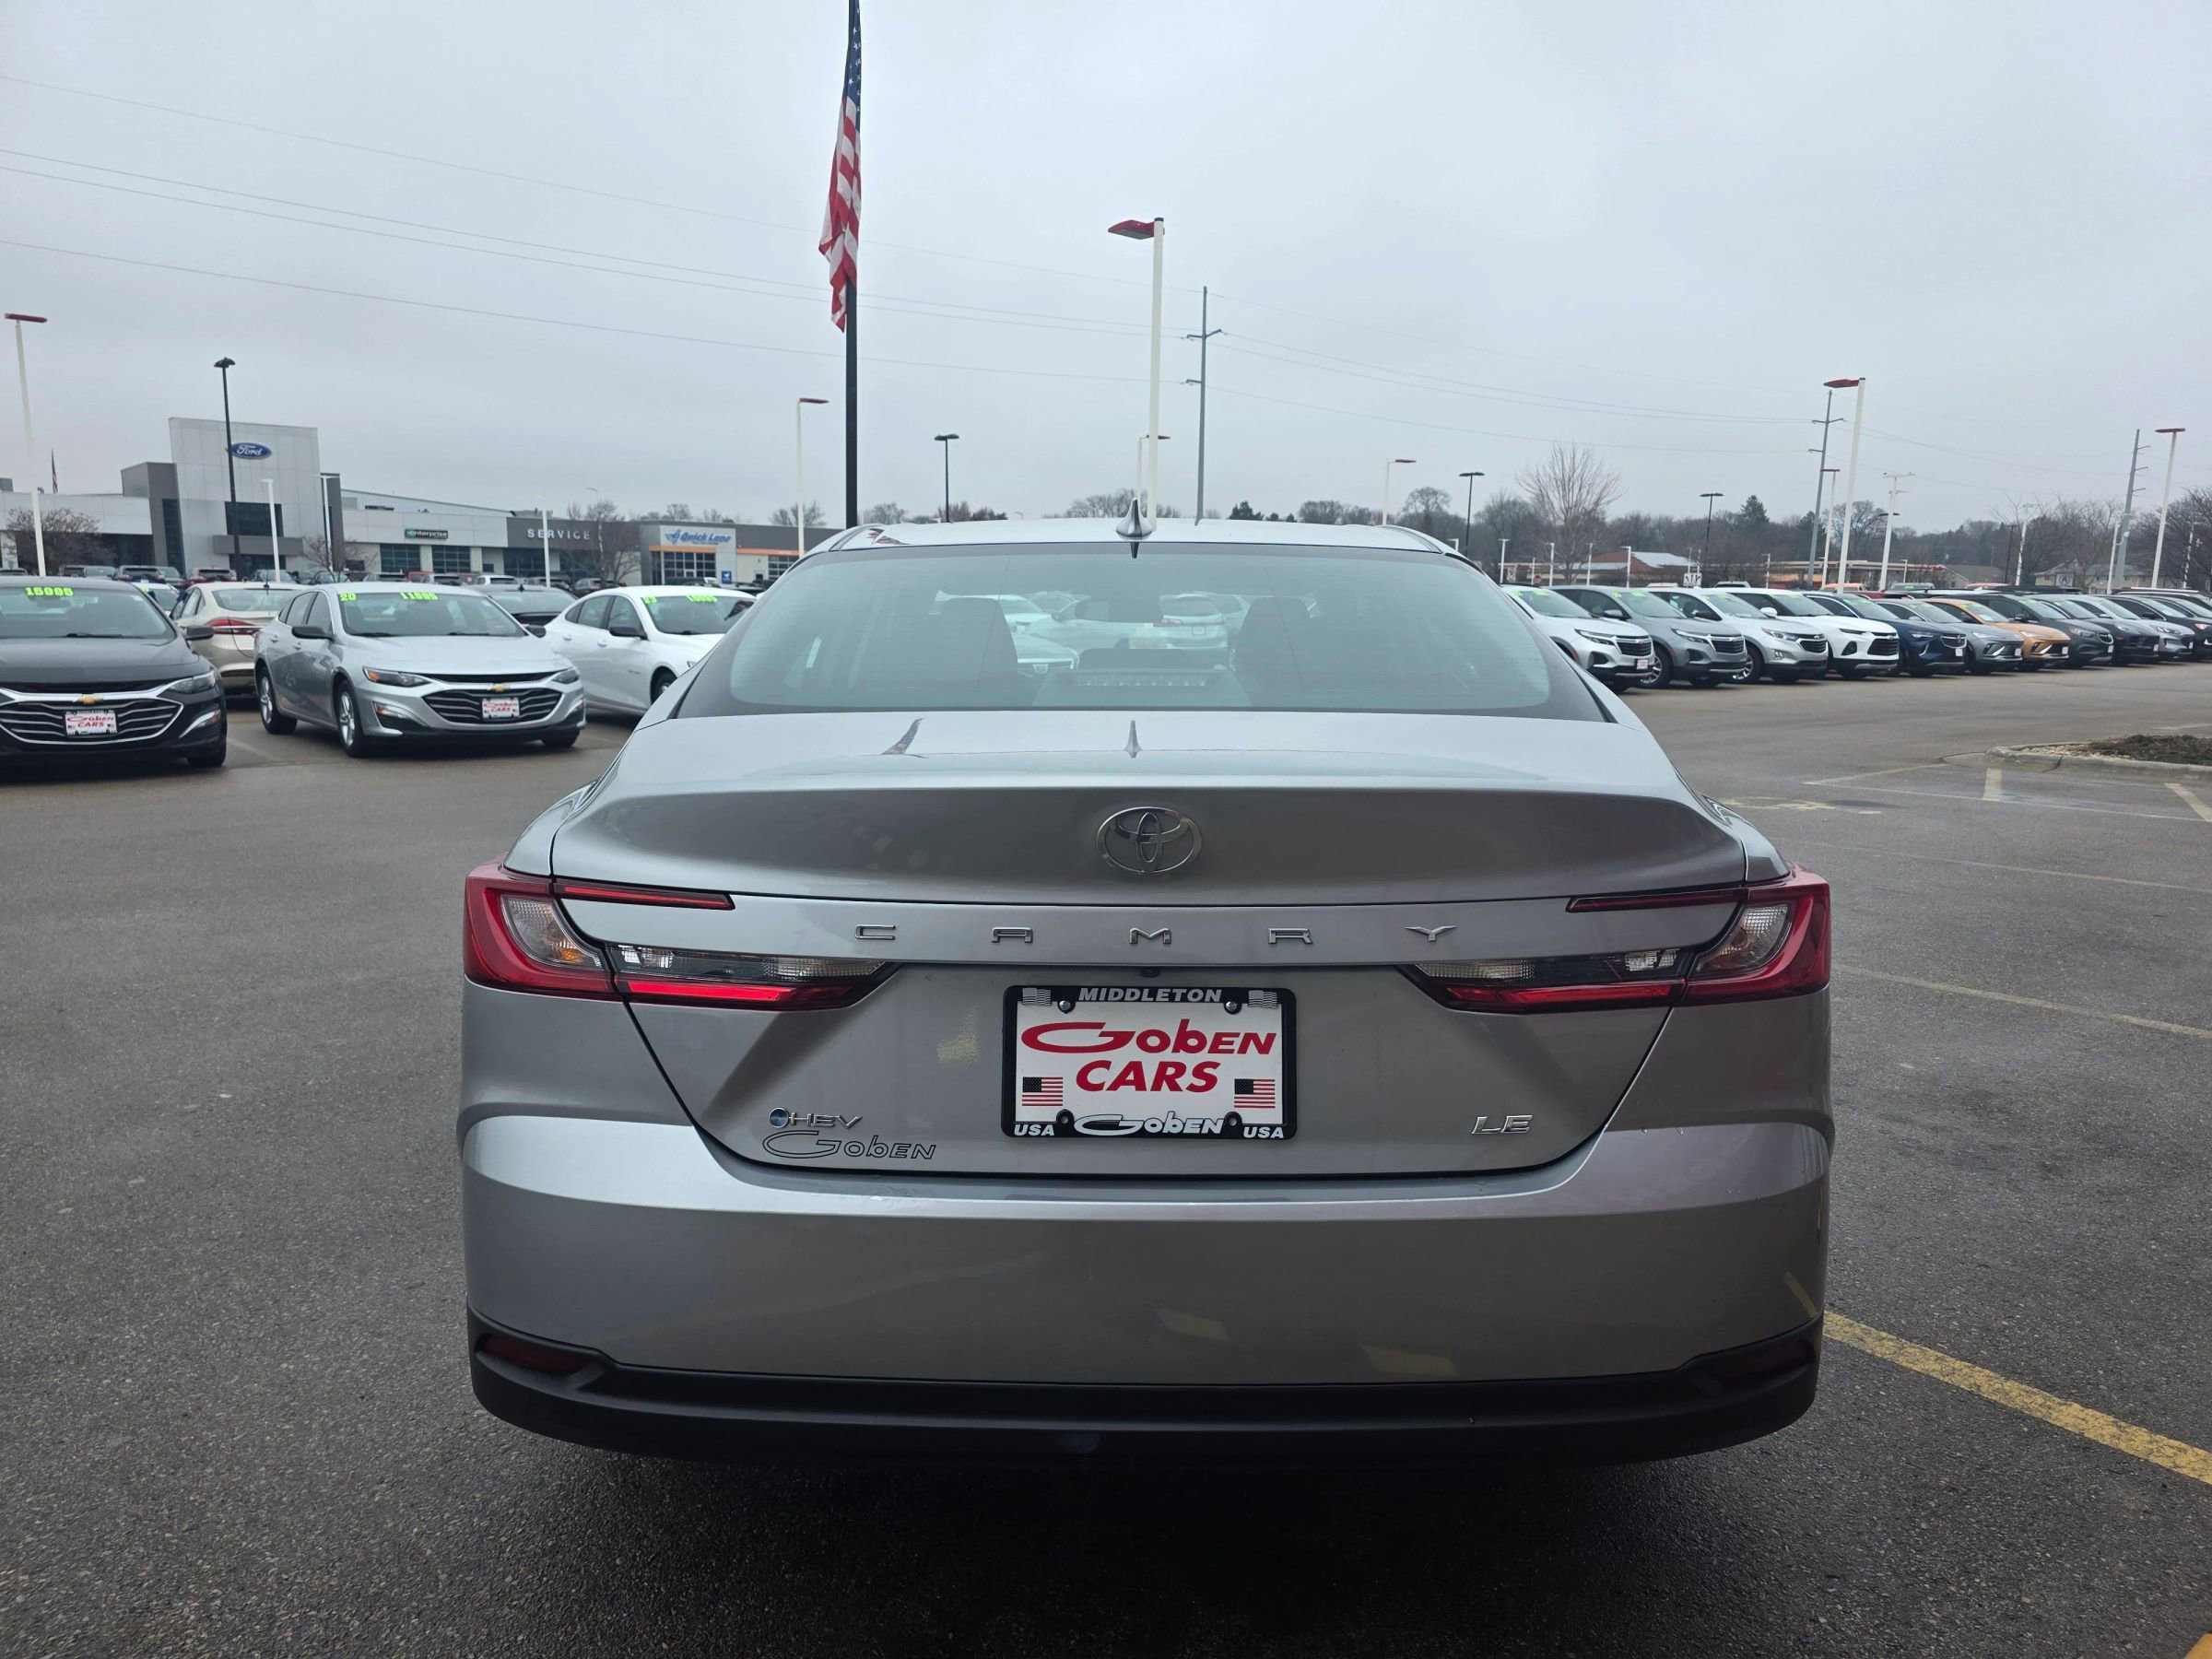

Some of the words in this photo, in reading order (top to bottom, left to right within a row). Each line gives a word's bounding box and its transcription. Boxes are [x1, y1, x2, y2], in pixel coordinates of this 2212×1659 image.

[236, 444, 264, 456] Ford
[527, 528, 591, 540] SERVICE
[680, 531, 707, 542] Quick
[708, 534, 732, 543] Lane
[853, 924, 1457, 945] CAMRY
[1078, 987, 1222, 1003] MIDDLETON
[1076, 1059, 1221, 1093] CARS
[1014, 1124, 1055, 1136] USA
[1243, 1126, 1284, 1139] USA
[1471, 1114, 1534, 1135] LE
